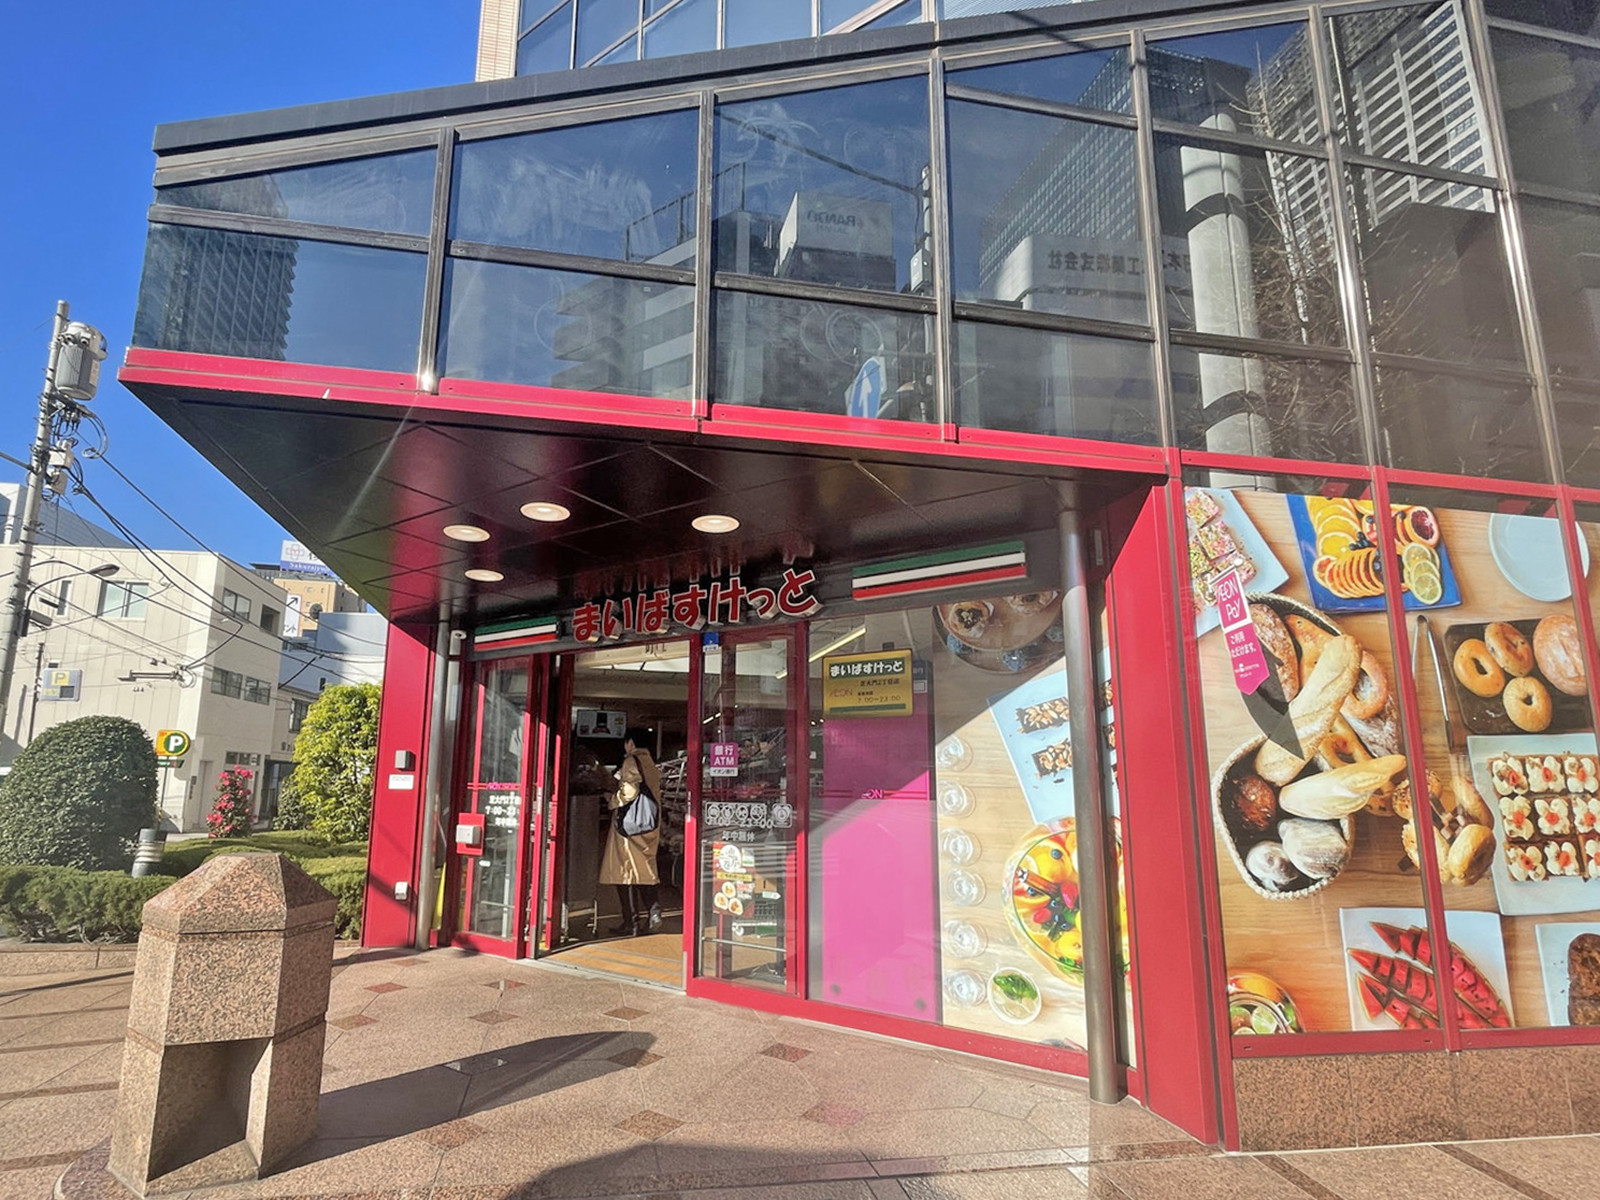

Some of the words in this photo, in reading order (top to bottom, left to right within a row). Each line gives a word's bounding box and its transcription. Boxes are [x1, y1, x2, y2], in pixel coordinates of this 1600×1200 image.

[571, 568, 816, 642] まいばすけっと
[830, 660, 903, 677] まいばすけっと
[54, 672, 66, 684] P
[168, 735, 184, 752] P
[714, 744, 734, 756] 銀行
[713, 756, 735, 766] ATM
